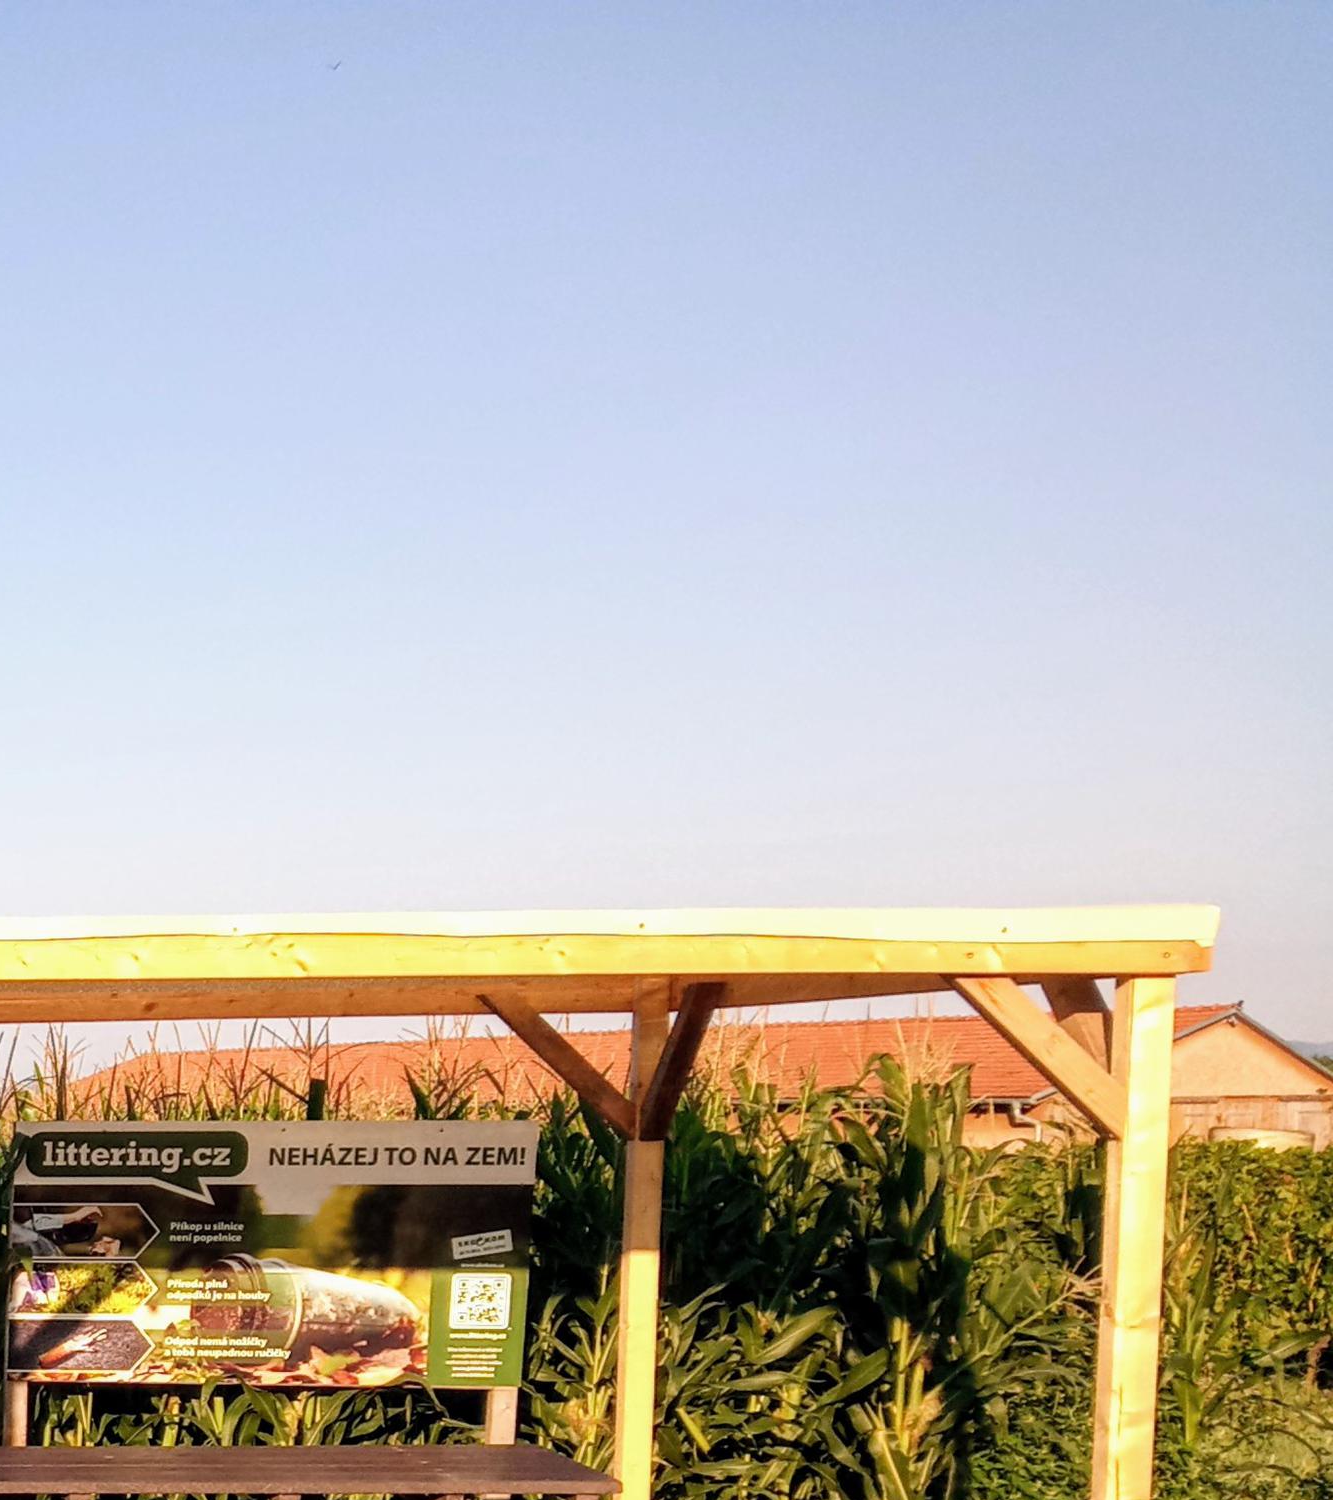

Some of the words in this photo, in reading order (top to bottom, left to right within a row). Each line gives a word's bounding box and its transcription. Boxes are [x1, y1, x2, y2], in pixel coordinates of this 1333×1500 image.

[42, 1140, 232, 1174] littering.cz
[268, 1143, 379, 1167] NEHÁZEJ
[384, 1146, 417, 1167] TO
[423, 1146, 459, 1167] NA
[465, 1146, 527, 1167] ZEM!
[169, 1221, 203, 1232] Příkop
[204, 1223, 212, 1231] u
[212, 1221, 245, 1231] silnice
[169, 1232, 192, 1242] není
[192, 1232, 243, 1244] popelnice
[204, 1279, 229, 1290] plná
[212, 1291, 223, 1301] je
[223, 1292, 237, 1300] na
[237, 1290, 271, 1302] houby
[164, 1336, 199, 1347] Odpad
[199, 1336, 228, 1346] nemá
[163, 1349, 171, 1357] a
[172, 1348, 196, 1357] tobě
[196, 1348, 254, 1359] neupadnou
